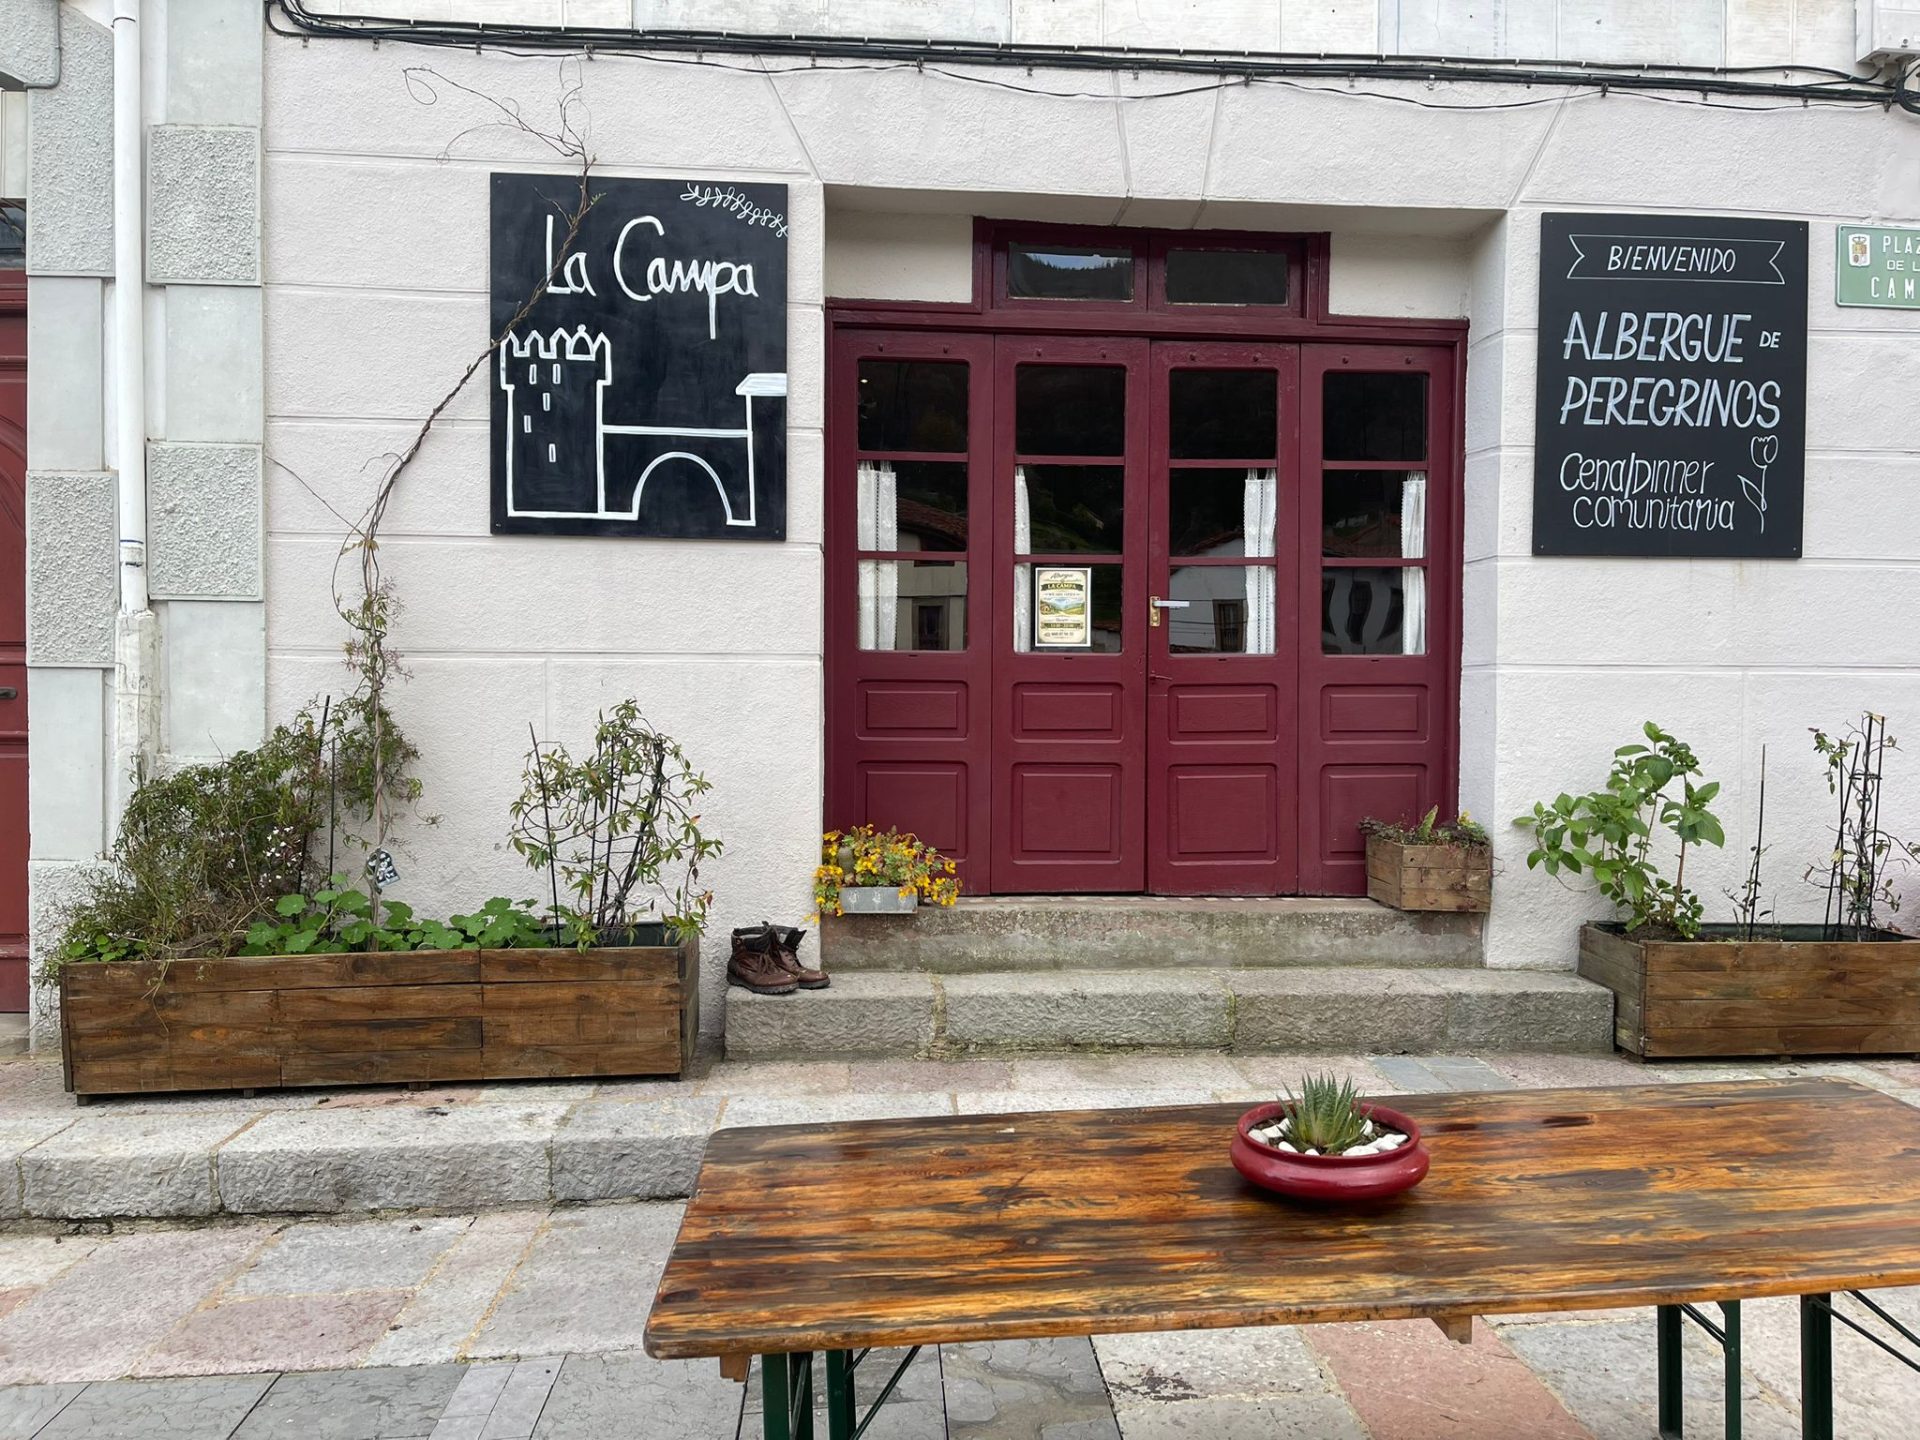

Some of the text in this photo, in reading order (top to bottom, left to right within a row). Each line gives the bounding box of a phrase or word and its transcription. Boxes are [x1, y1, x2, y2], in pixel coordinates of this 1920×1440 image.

[546, 214, 759, 339] La Campa
[1607, 245, 1737, 274] BIENVENIDO
[1886, 259, 1904, 271] DE
[1871, 276, 1915, 300] CAM
[1562, 311, 1782, 363] ALBERGUE DE
[1559, 376, 1781, 428] PEREGRINOS
